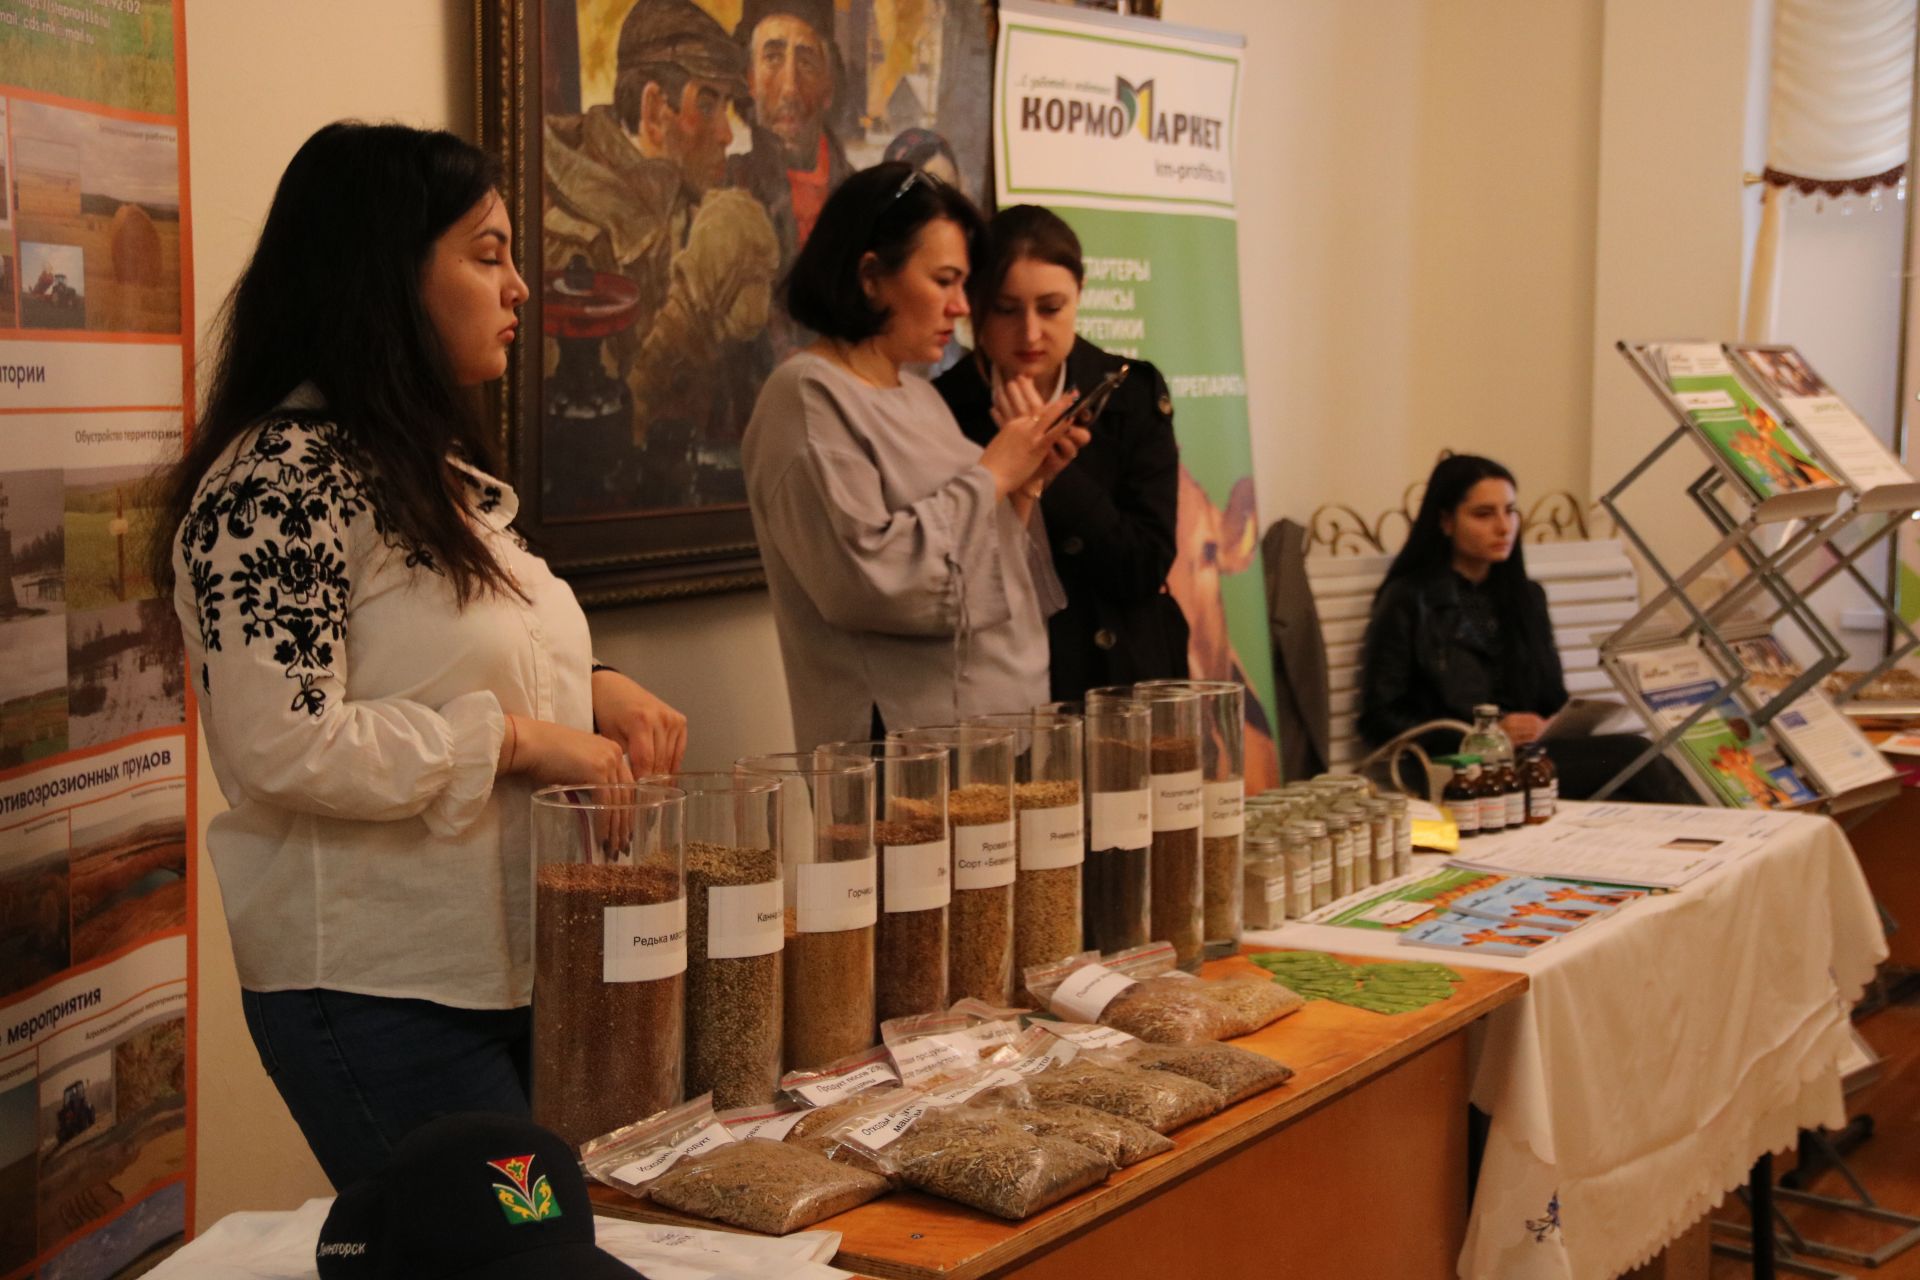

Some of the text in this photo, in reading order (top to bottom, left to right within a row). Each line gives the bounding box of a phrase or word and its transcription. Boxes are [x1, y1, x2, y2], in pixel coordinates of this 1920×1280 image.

[1083, 256, 1151, 282] ТАРТЕРЫ
[123, 750, 172, 780] прудов
[633, 935, 668, 946] Редька
[7, 987, 101, 1045] мероприятия
[861, 1118, 891, 1136] Отходы
